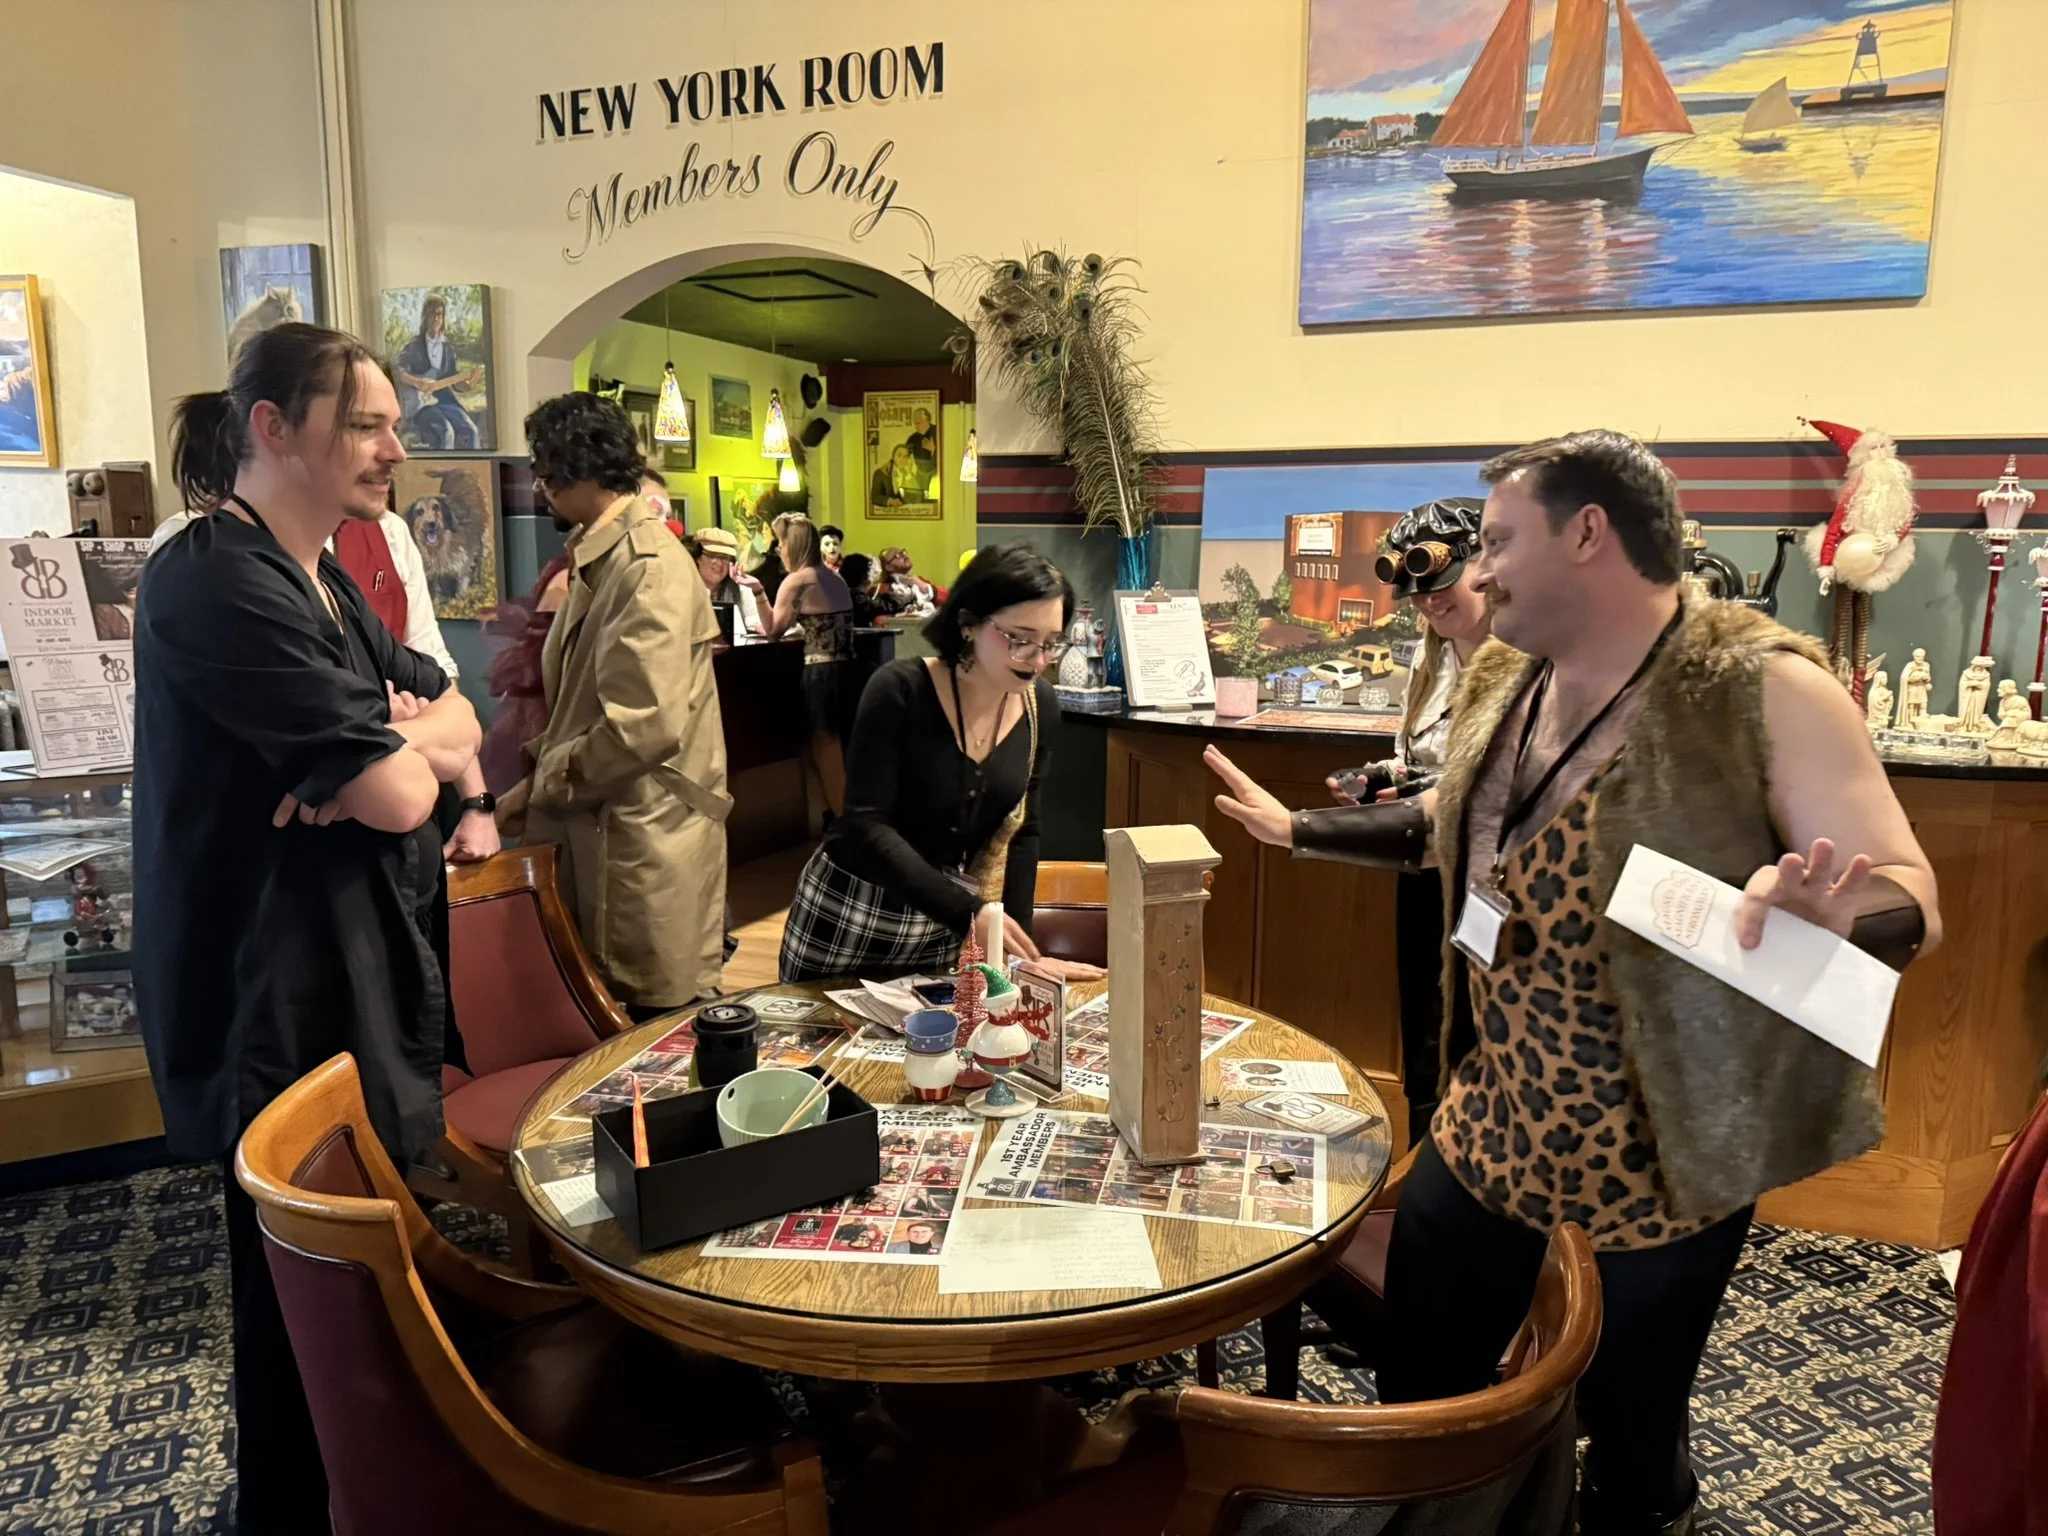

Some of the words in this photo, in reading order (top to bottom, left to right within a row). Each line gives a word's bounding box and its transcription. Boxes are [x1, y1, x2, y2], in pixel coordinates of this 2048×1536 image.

[538, 83, 637, 141] NEW
[657, 63, 787, 125] YORK
[802, 42, 945, 110] ROOM
[563, 143, 761, 259] Members
[787, 130, 934, 260] Only
[80, 541, 95, 552] SIP
[103, 541, 126, 552] SHOP
[24, 607, 75, 617] INDOOR
[24, 616, 78, 628] MARKET
[879, 1115, 976, 1123] ASSADOR
[1000, 1148, 1016, 1163] 1ST
[1008, 1122, 1029, 1148] YEAR
[1009, 1112, 1047, 1178] AMBASSADOR
[1027, 1121, 1056, 1168] MEMBERS
